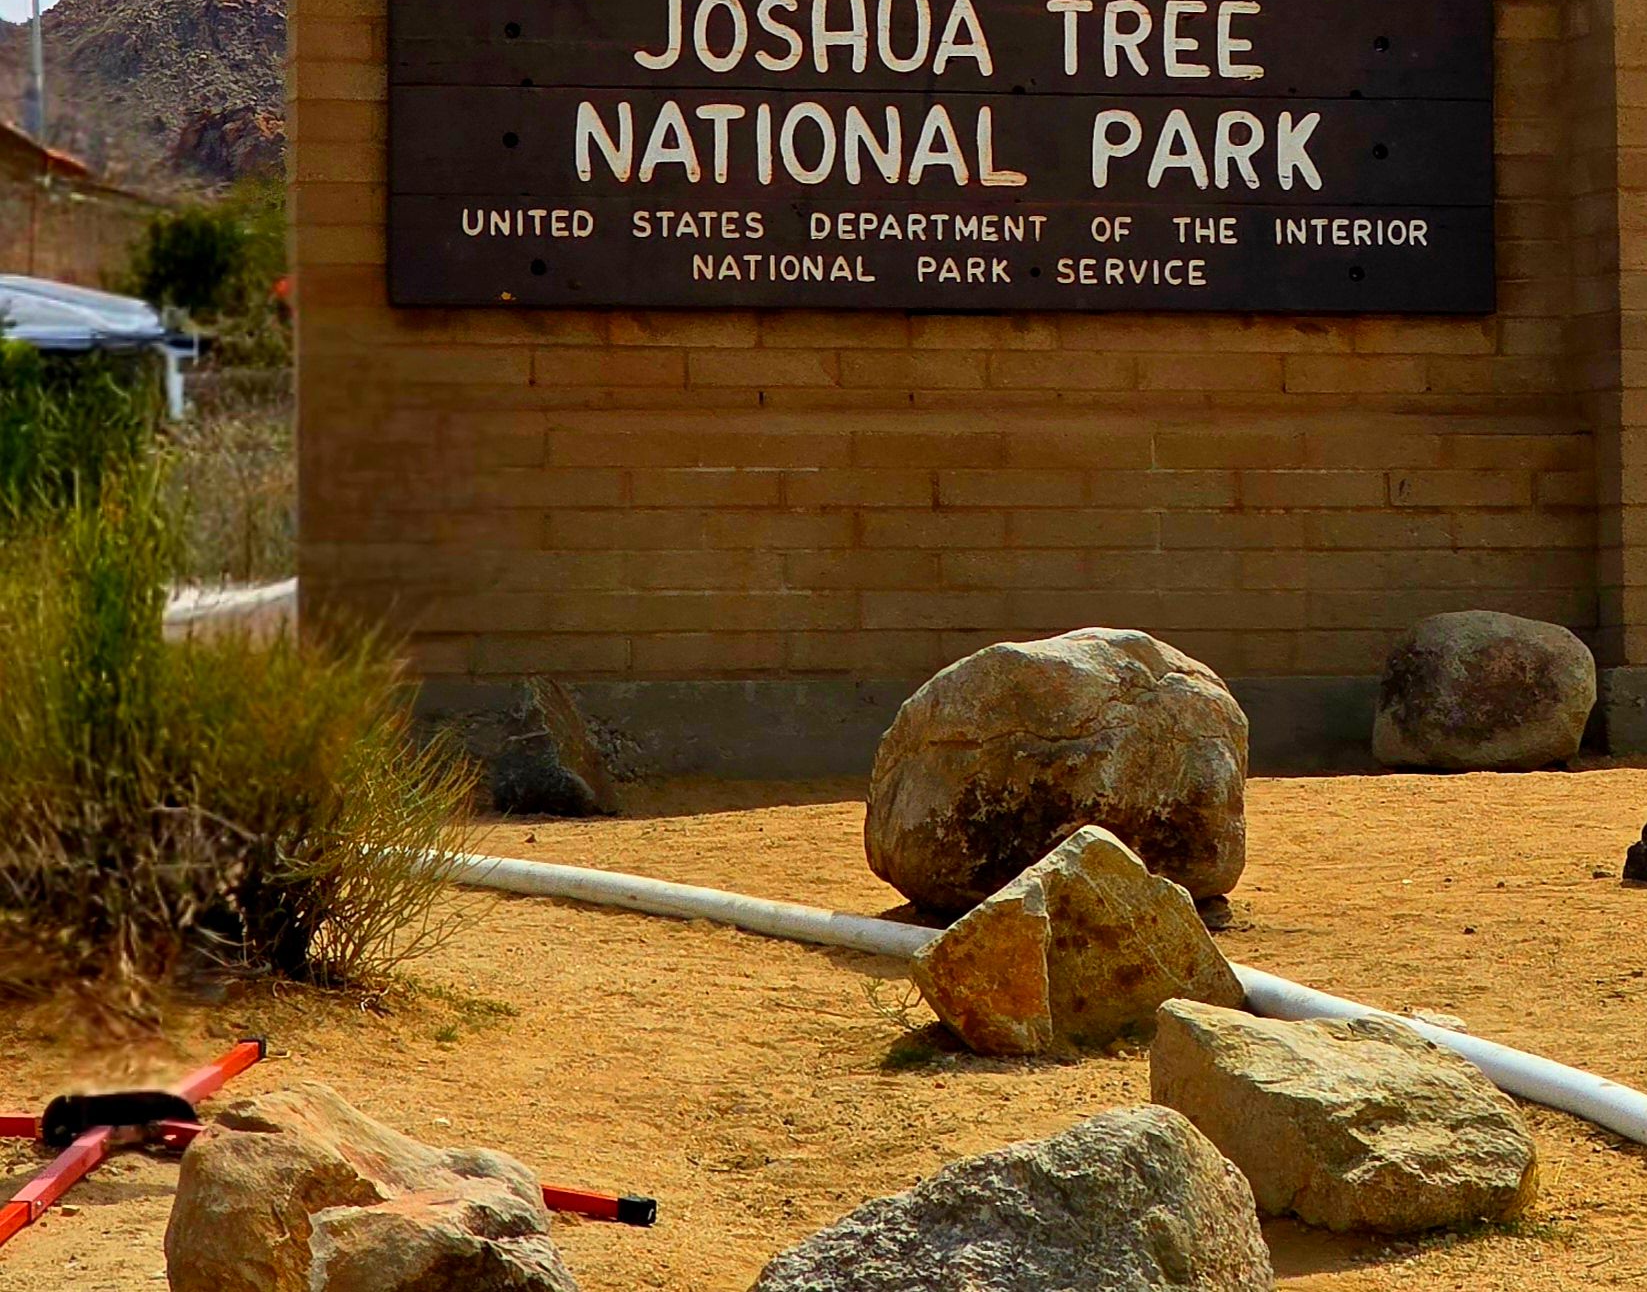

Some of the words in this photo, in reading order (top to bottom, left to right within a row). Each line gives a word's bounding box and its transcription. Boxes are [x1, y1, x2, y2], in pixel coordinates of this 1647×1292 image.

[575, 100, 1027, 187] NATIONAL
[1092, 109, 1323, 191] PARK
[462, 208, 594, 238] UNITED
[632, 210, 764, 239] STATES
[810, 212, 1047, 242] DEPARTMENT
[1091, 216, 1132, 243] OF
[1172, 216, 1238, 244] THE
[1275, 218, 1428, 246] INTERIOR
[693, 254, 876, 283] NATIONAL
[917, 256, 1011, 283] PARK
[1056, 258, 1207, 286] SERVICE
